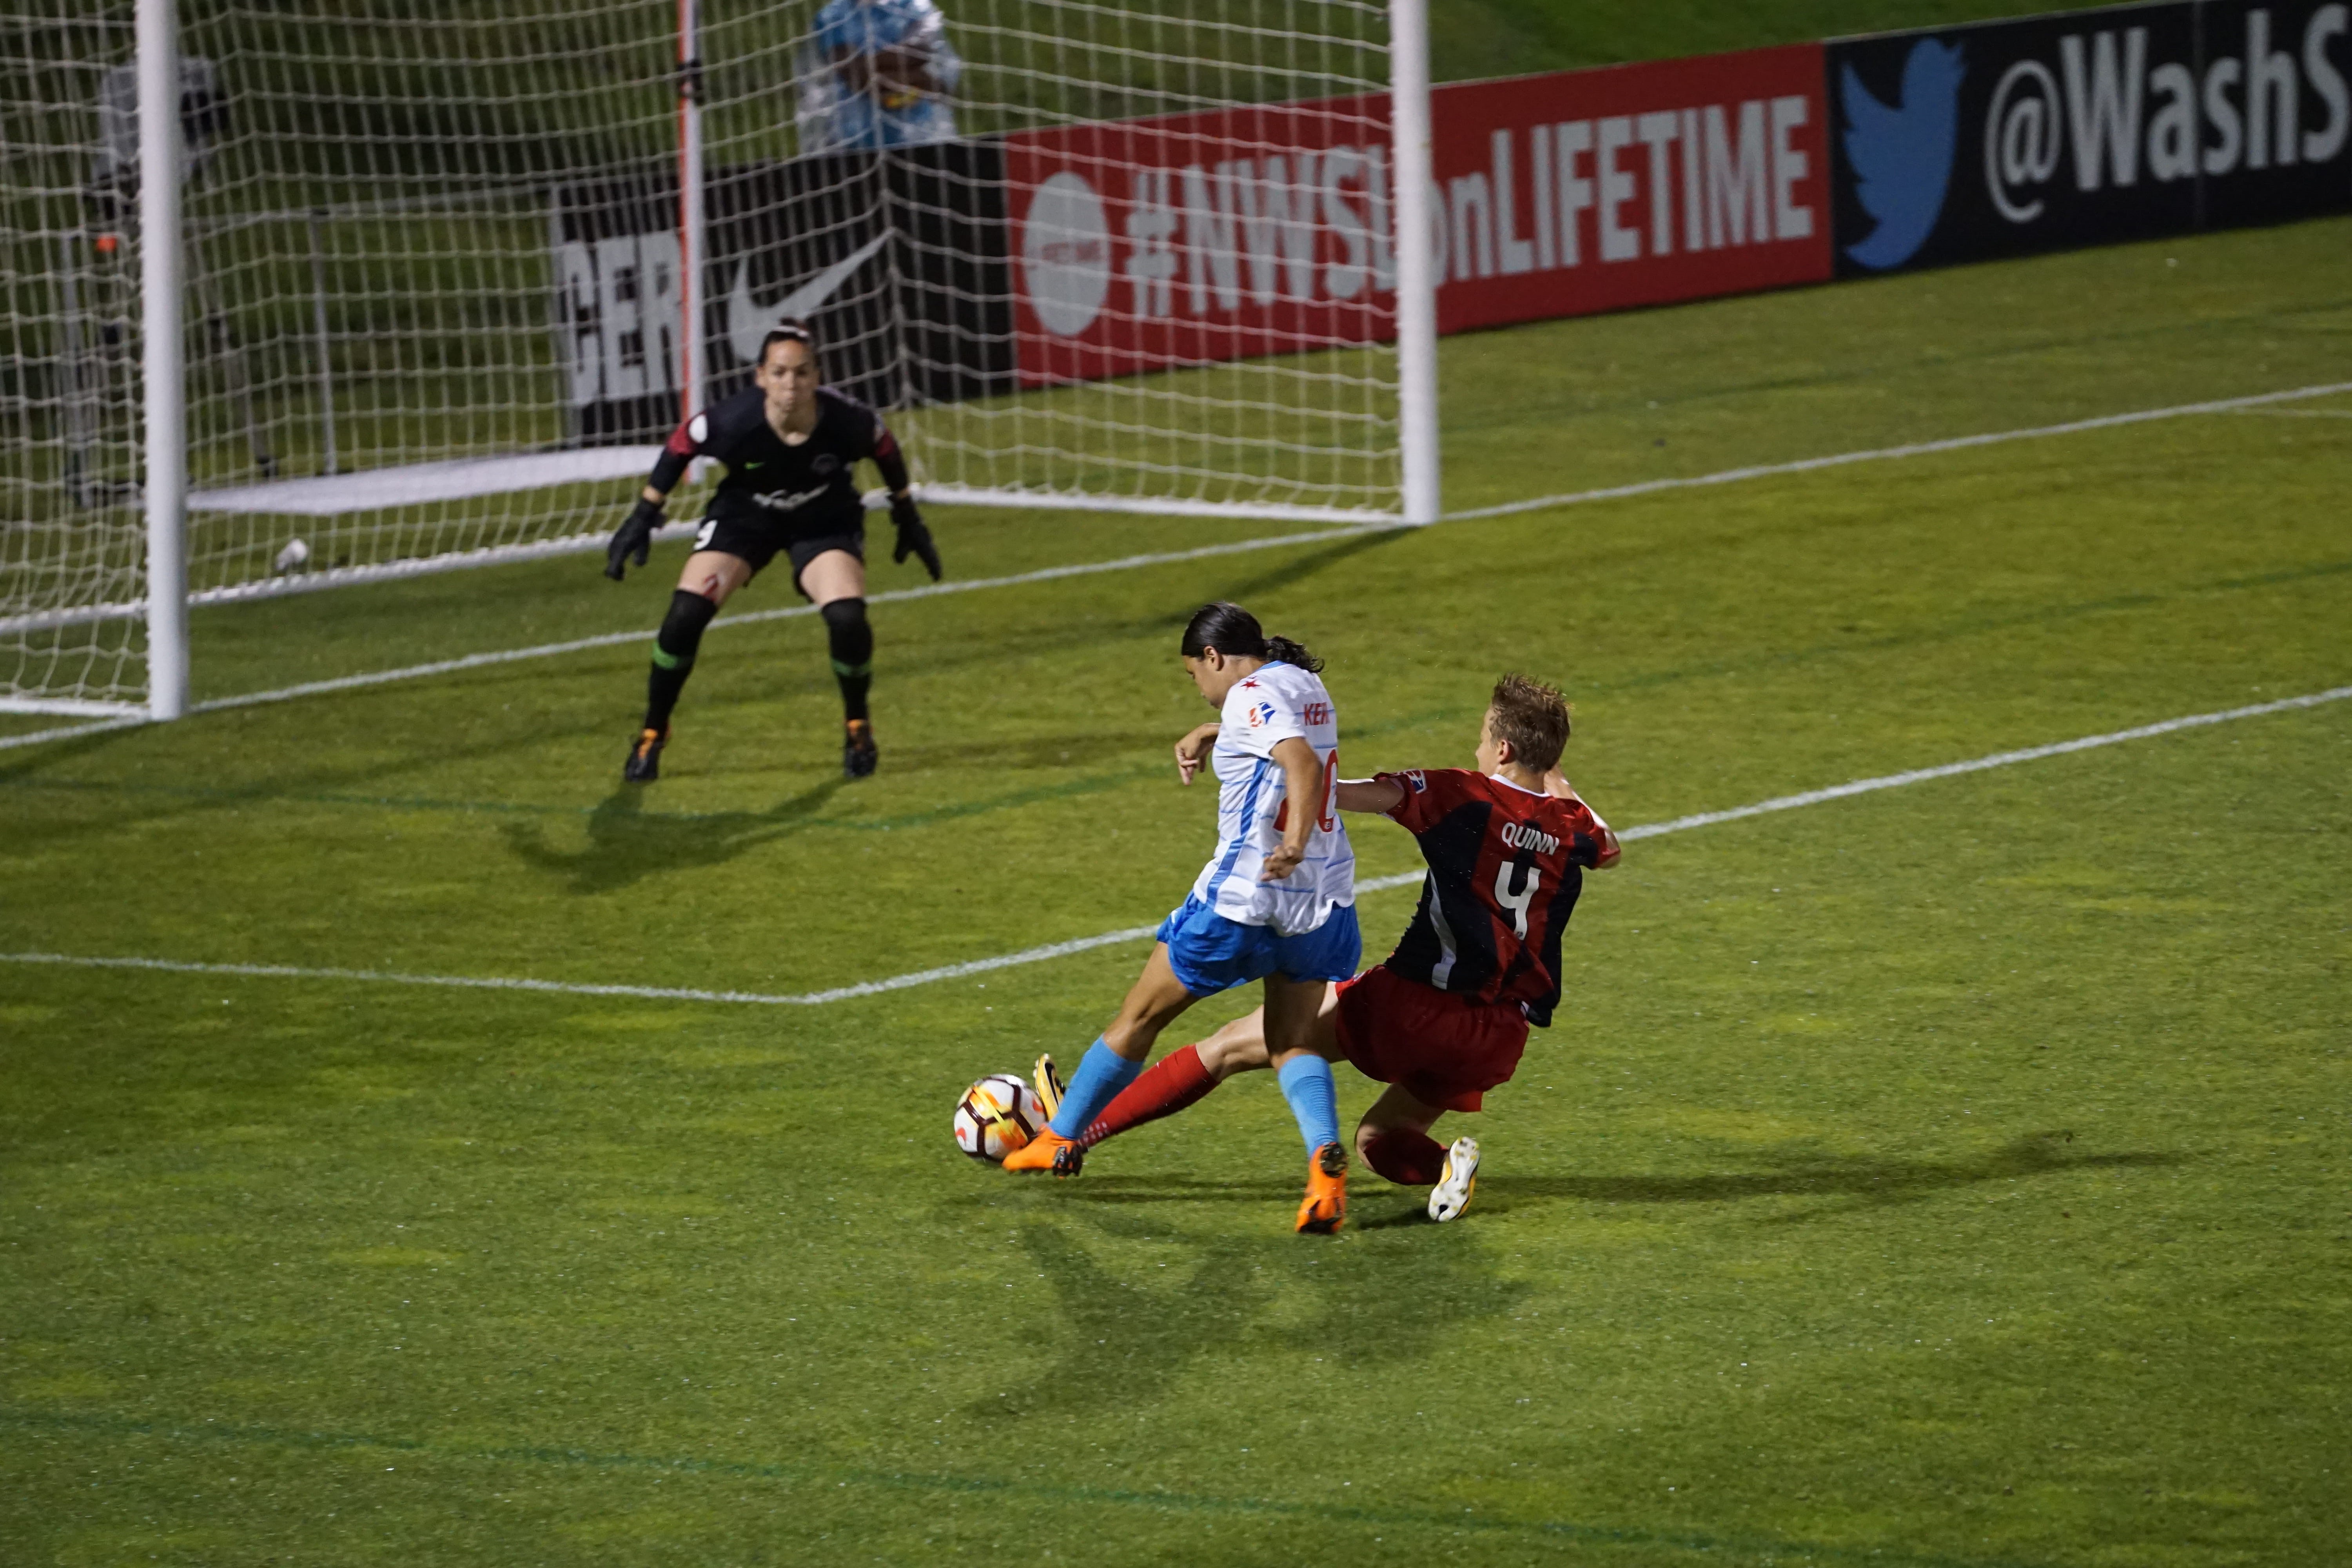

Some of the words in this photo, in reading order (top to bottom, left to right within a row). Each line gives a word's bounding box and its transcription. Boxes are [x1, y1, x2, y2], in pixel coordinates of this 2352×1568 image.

[1984, 2, 2351, 223] @WashS
[1501, 822, 1560, 856] QUINN
[1494, 860, 1542, 940] 4
